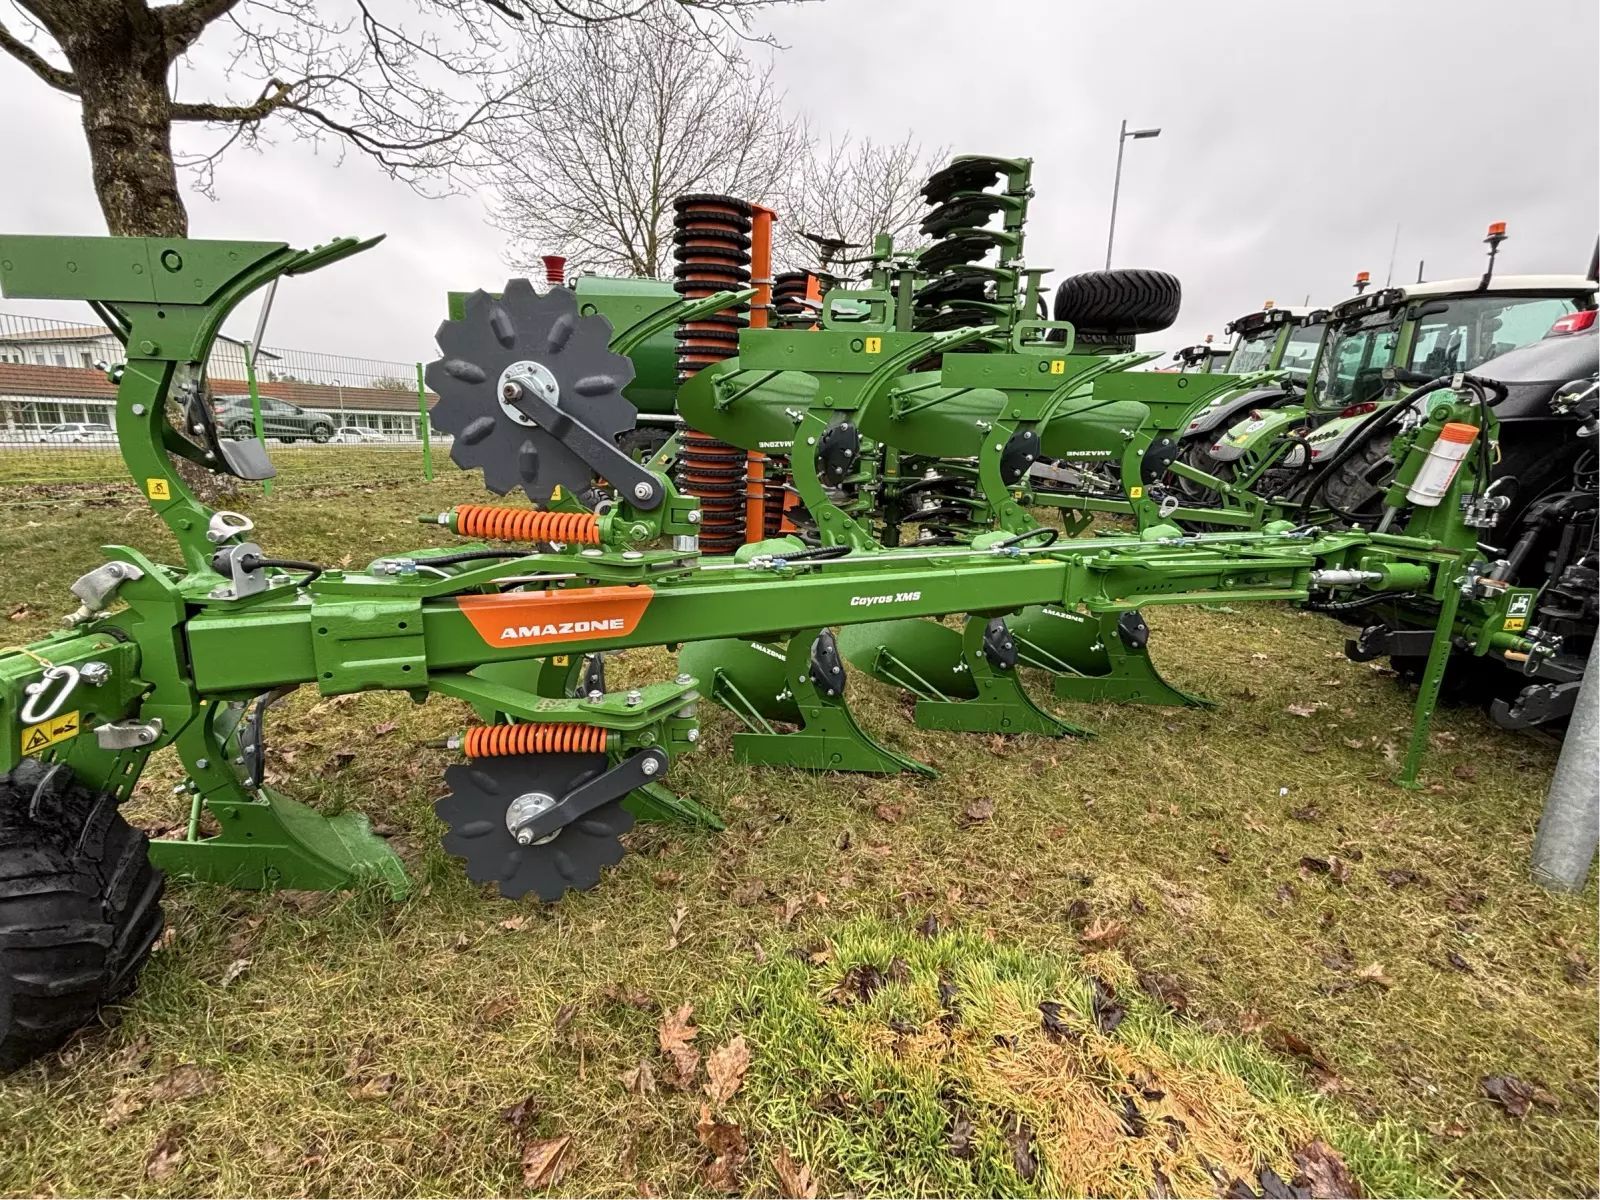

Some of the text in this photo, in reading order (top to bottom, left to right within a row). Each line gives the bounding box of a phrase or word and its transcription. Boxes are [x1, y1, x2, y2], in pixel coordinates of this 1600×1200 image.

[850, 591, 921, 607] Cayros XMS
[1042, 608, 1084, 623] AMAZONE
[500, 618, 625, 640] AMAZONE
[750, 642, 787, 662] AMAZONE
